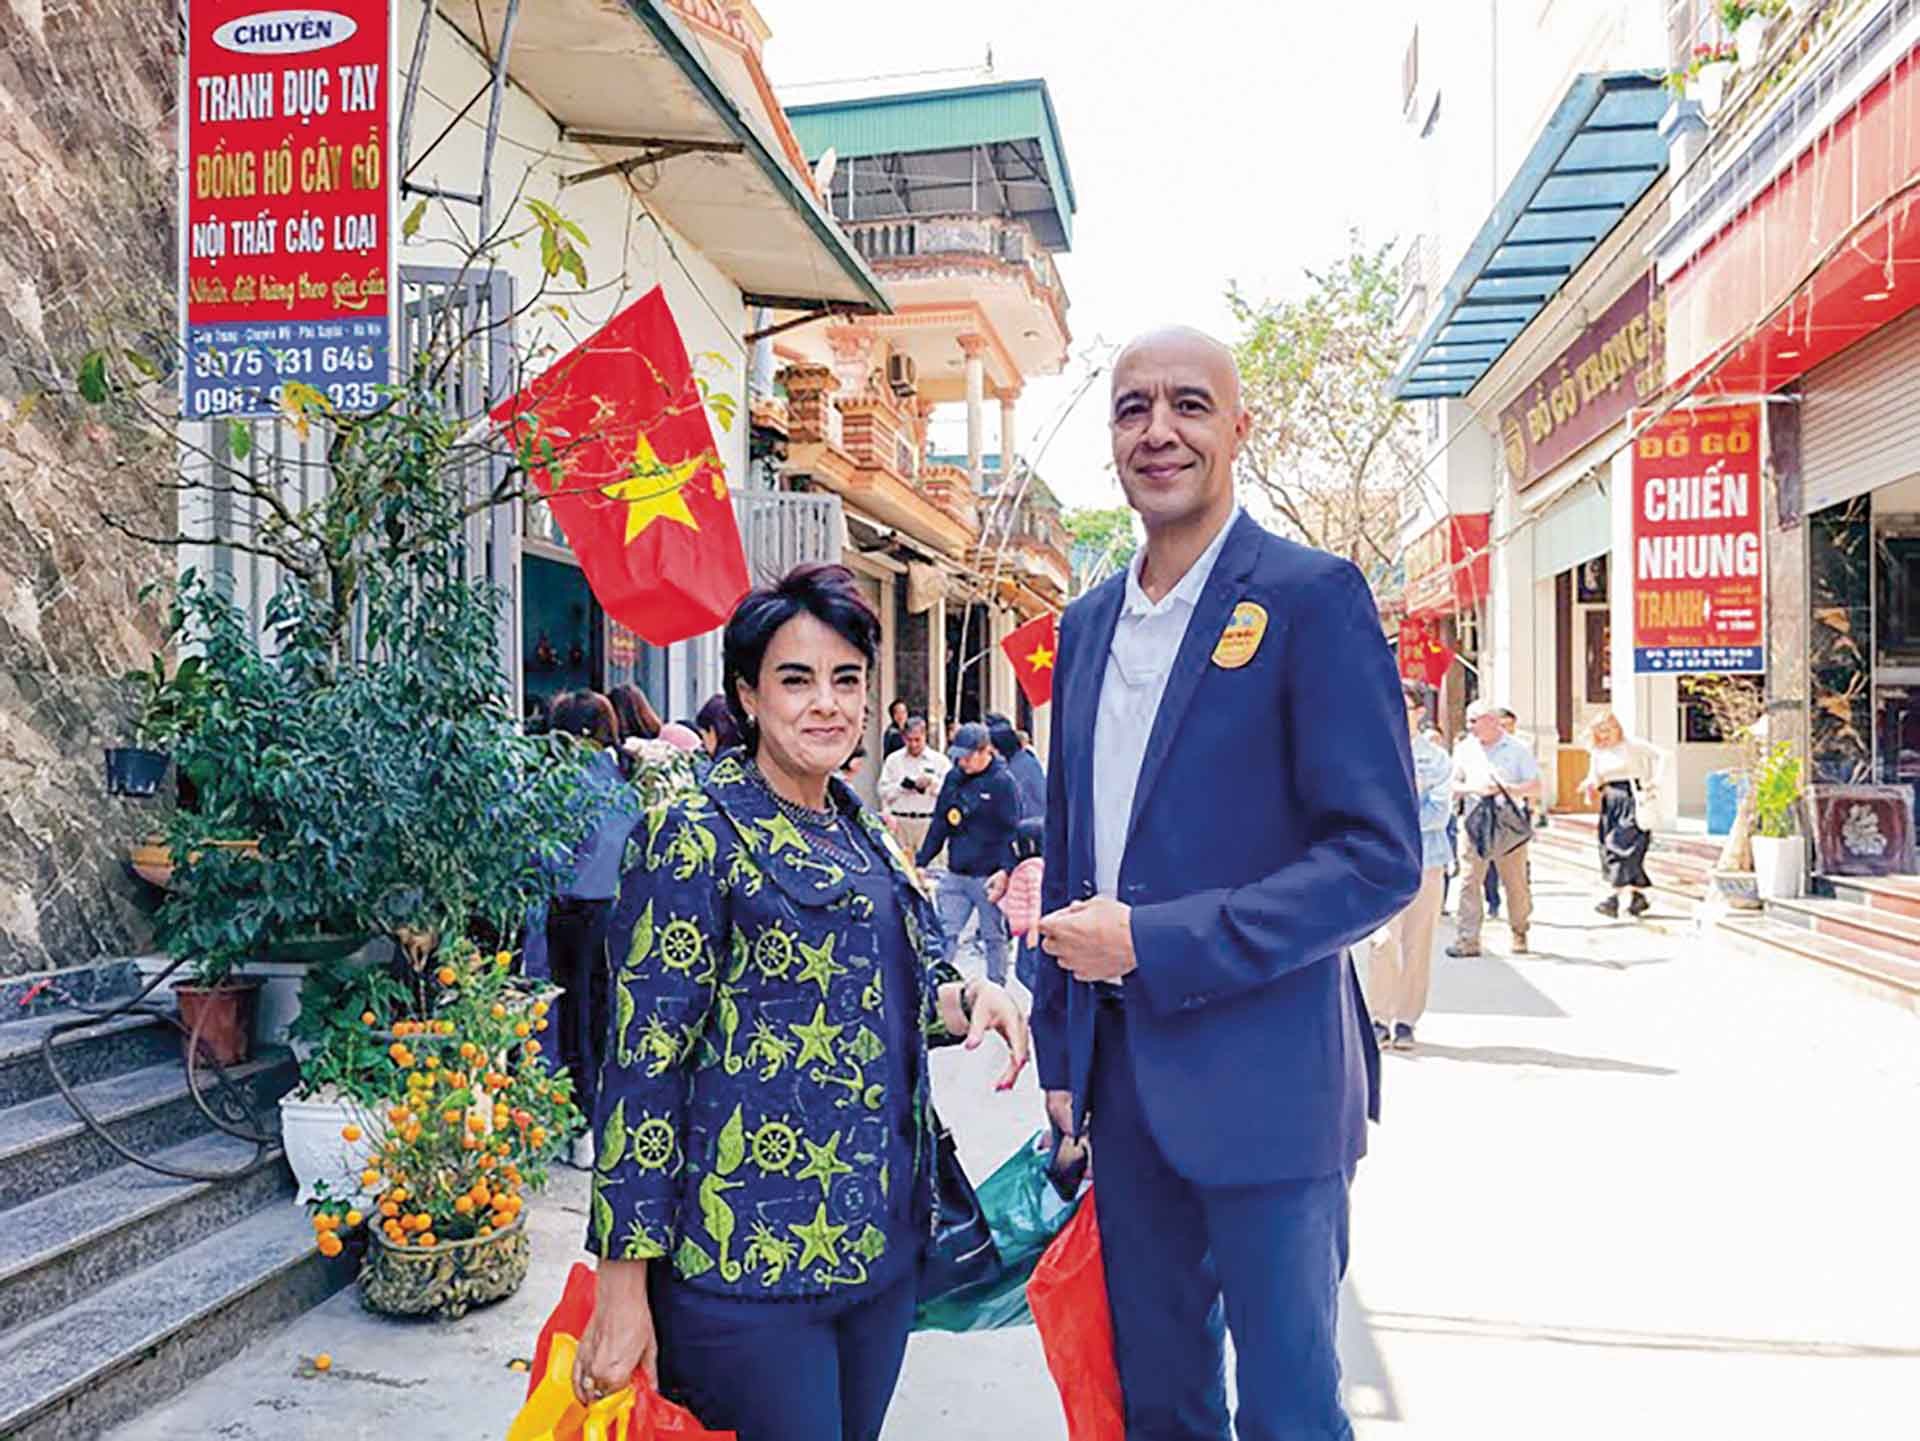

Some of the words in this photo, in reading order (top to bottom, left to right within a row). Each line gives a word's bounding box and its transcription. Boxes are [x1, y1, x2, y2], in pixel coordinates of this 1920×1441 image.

[234, 15, 332, 45] CHUYÊN
[197, 72, 274, 123] TRANH
[283, 67, 330, 125] ĐỤC
[338, 64, 379, 113] TAY
[196, 137, 257, 199] ĐỒNG
[263, 133, 295, 195] HỒ
[301, 136, 343, 193] CÂY
[351, 126, 381, 190] GỖ
[192, 214, 226, 268] NỘI
[231, 209, 278, 256] THẤT
[285, 209, 325, 254] CÁC
[333, 213, 377, 257] LOẠI
[259, 273, 295, 311] hàng
[298, 271, 329, 299] theo
[327, 382, 379, 409] 935
[1643, 459, 1749, 523] CHIẾN
[1637, 531, 1759, 581] NHUNG
[1639, 589, 1704, 630] TRANH
